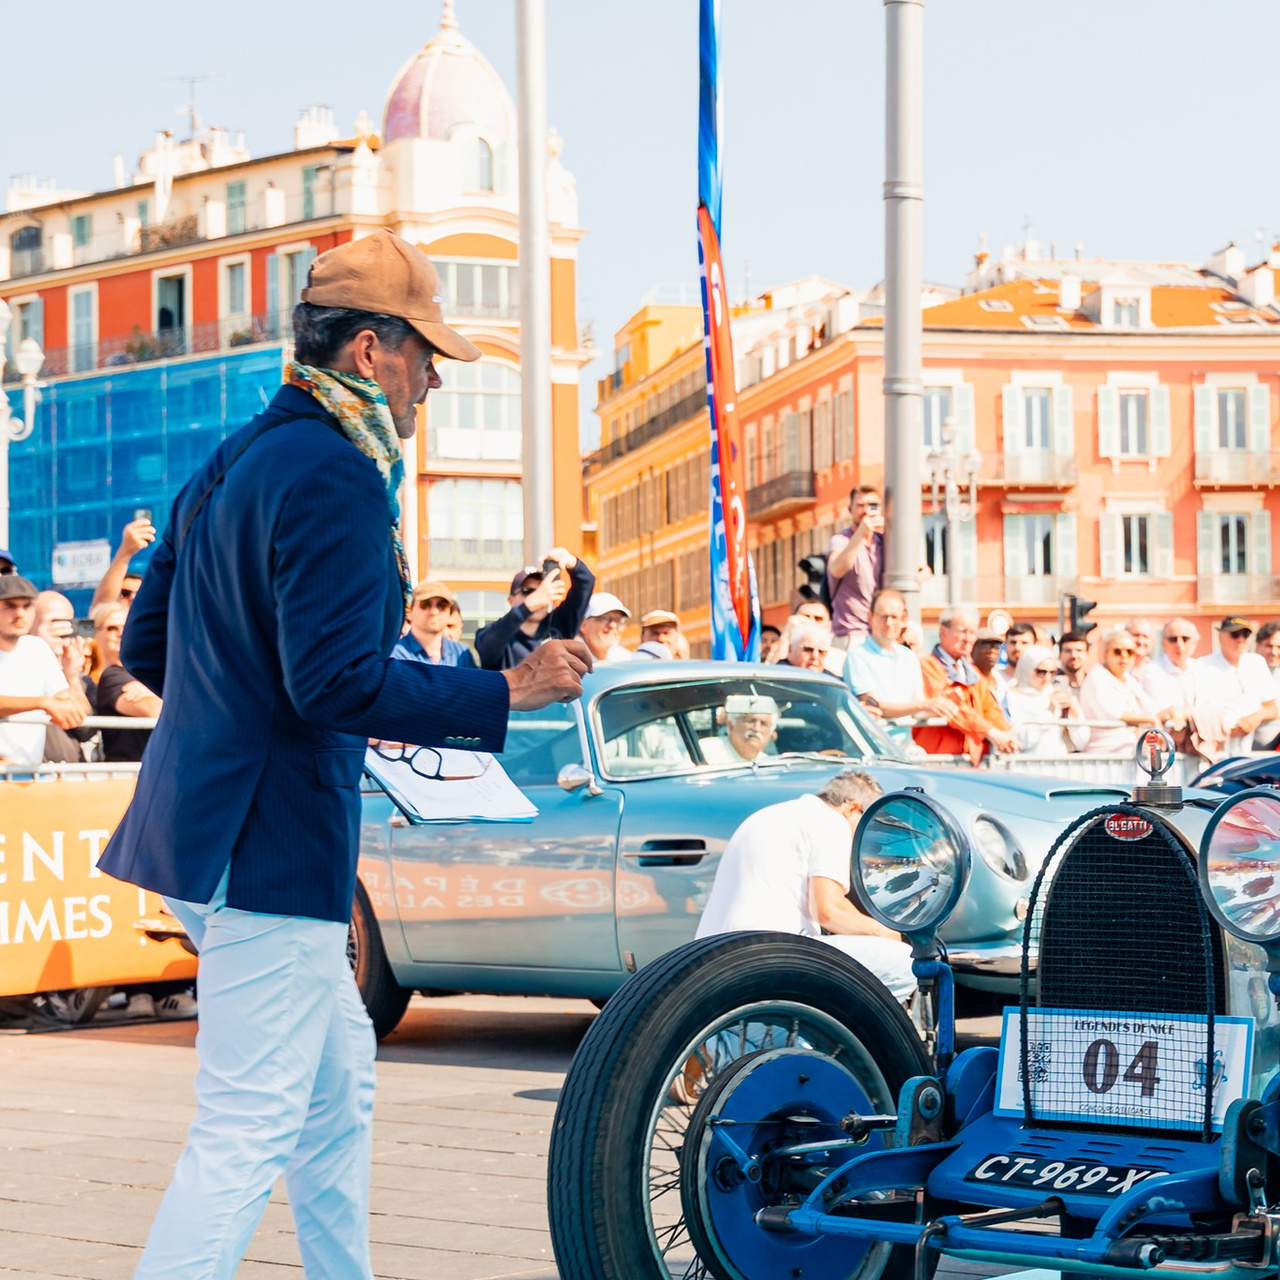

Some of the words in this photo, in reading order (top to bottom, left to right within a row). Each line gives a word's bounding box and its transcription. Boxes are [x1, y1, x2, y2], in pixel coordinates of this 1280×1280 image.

[1150, 1023, 1176, 1035] NICE
[1083, 1038, 1160, 1097] 04
[974, 1155, 1170, 1194] CT-969-X
